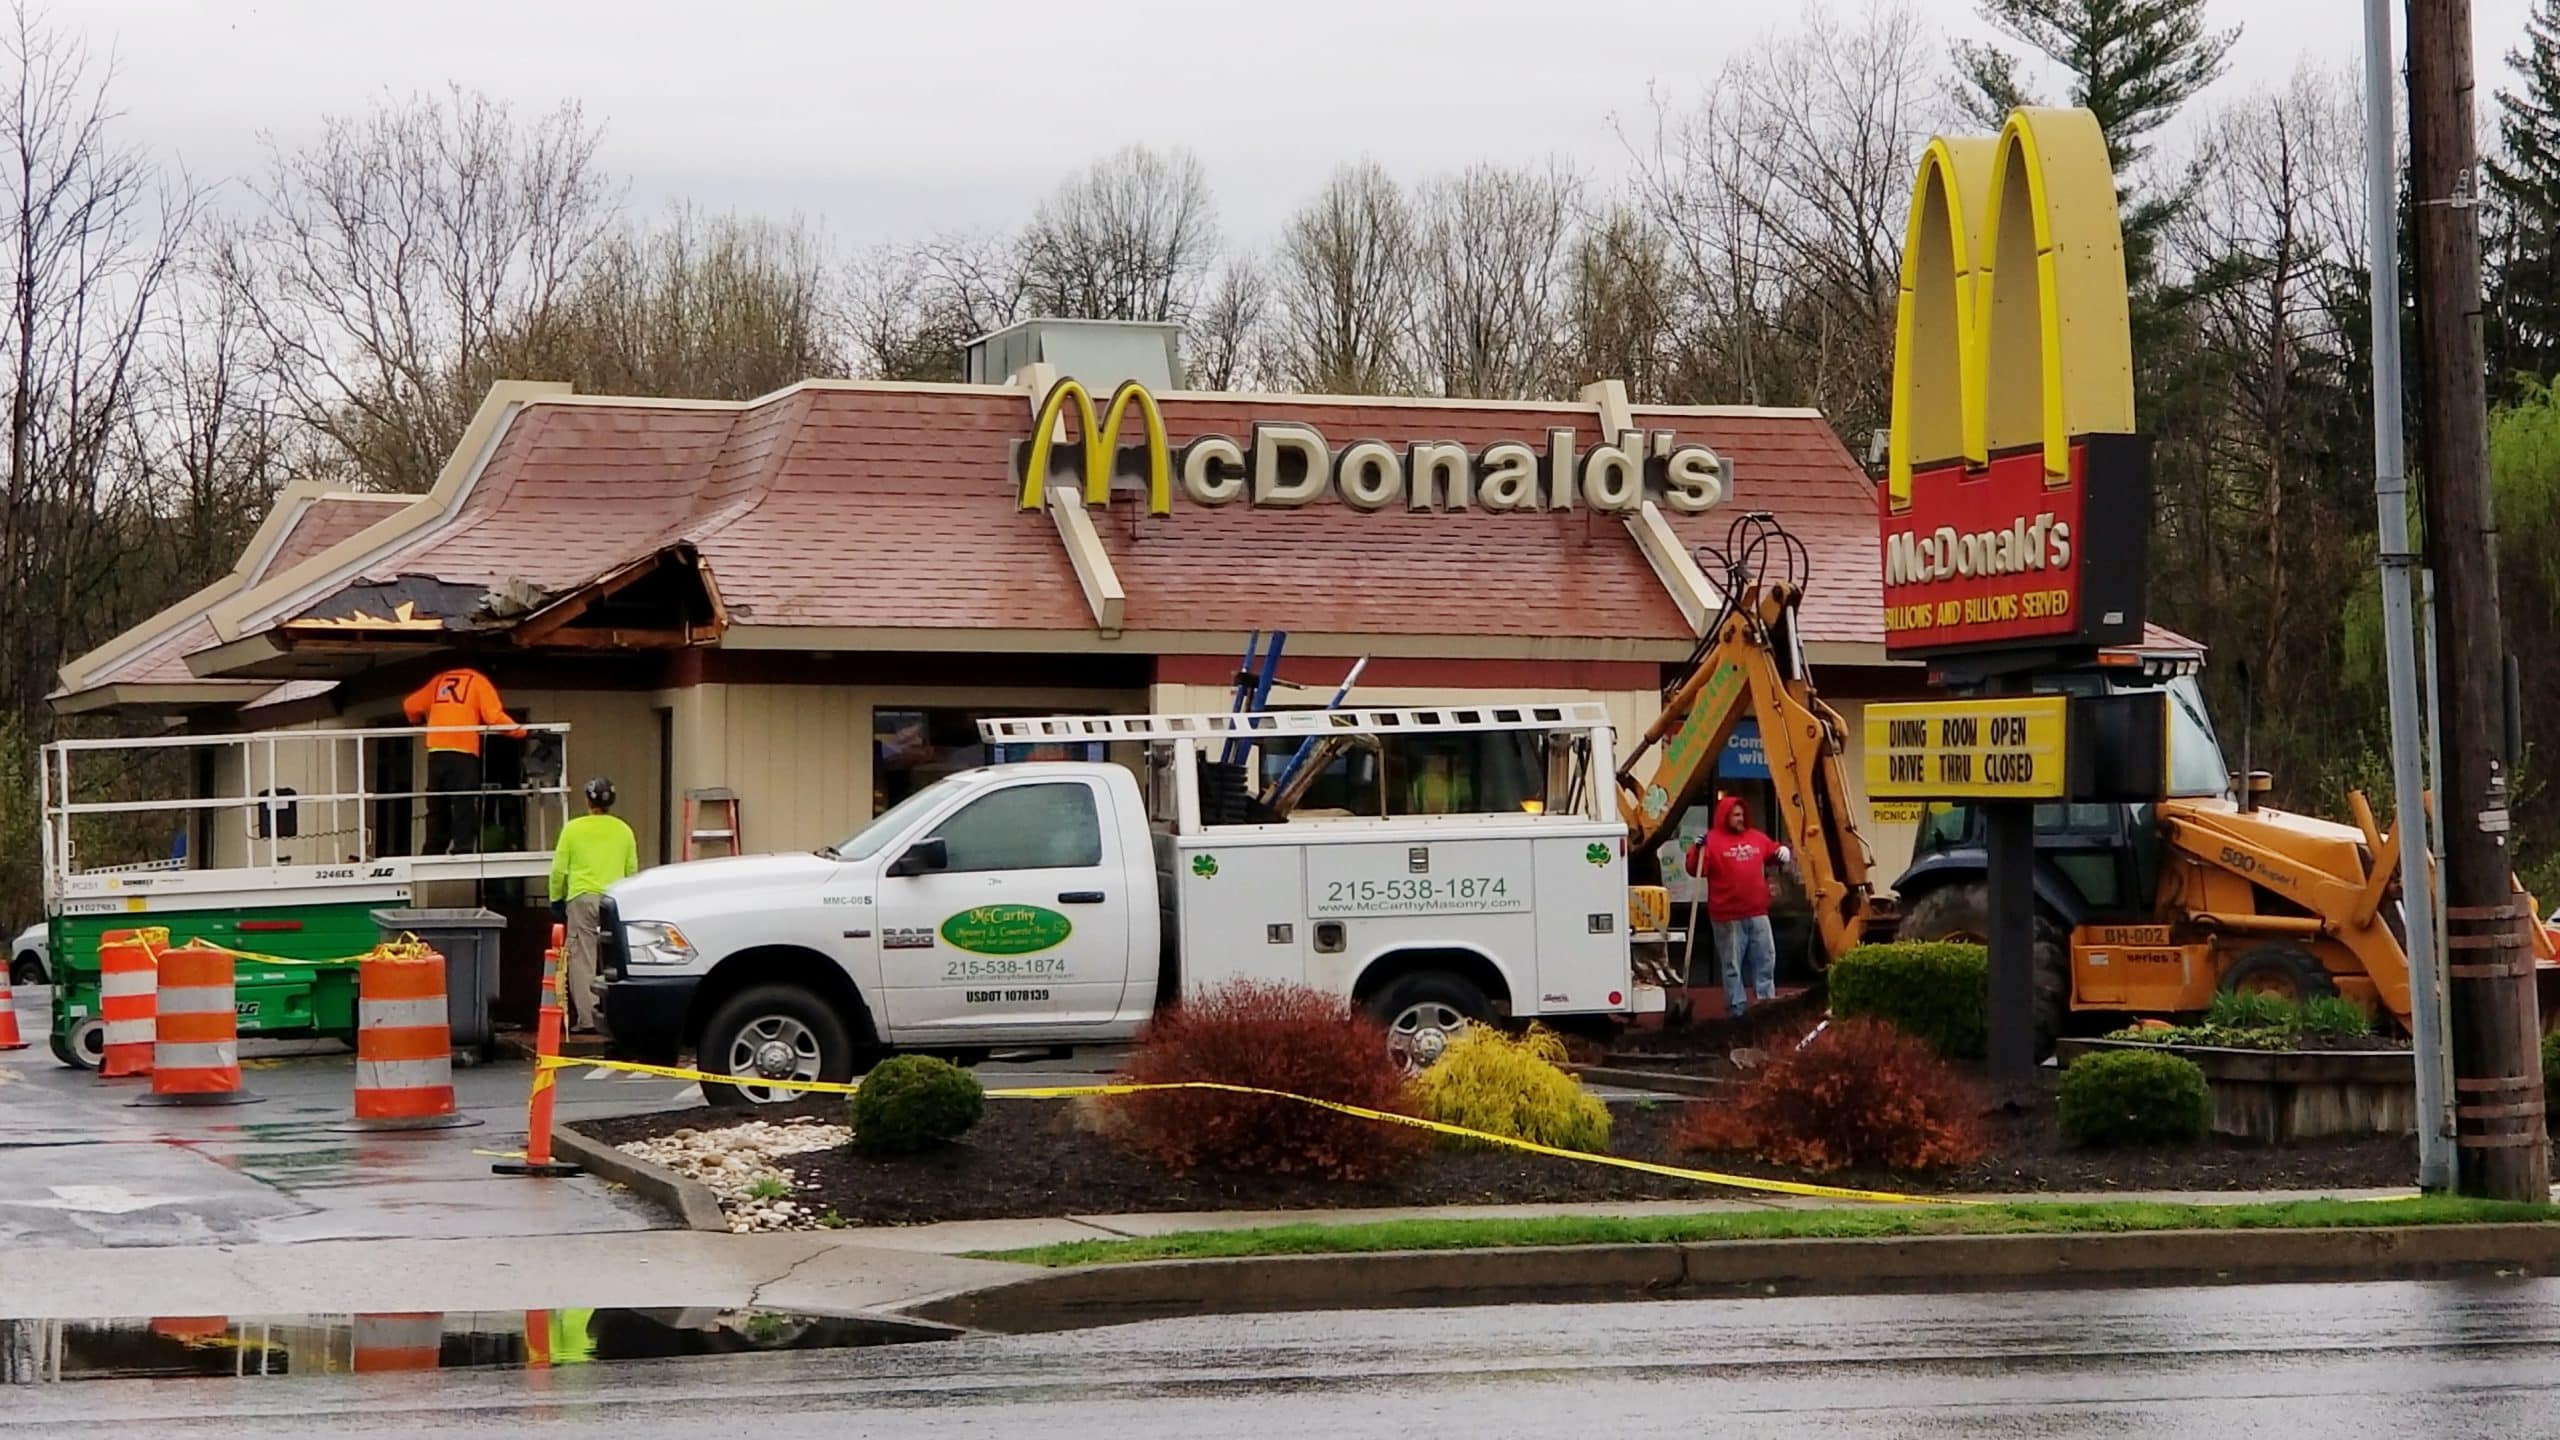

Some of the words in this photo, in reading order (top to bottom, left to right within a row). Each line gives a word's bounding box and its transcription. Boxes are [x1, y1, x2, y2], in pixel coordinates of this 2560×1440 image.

[1018, 377, 1726, 517] McDonald's
[1886, 513, 2070, 587] McDonald's
[1885, 603, 1932, 631] BILLIONS
[1937, 600, 1961, 626] AND
[1965, 594, 2018, 624] BILLIONS
[2022, 590, 2068, 618] SERVED
[1889, 720, 1927, 748] DINING
[1942, 717, 1977, 747] ROOM
[1990, 717, 2026, 747] OPEN
[1727, 735, 1764, 748] Com
[1738, 750, 1769, 765] wit
[1889, 754, 1924, 782] DRIVE
[1939, 754, 1971, 782] THRU
[1984, 753, 2033, 783] CLOSED
[1873, 810, 1907, 821] PICNIC
[368, 867, 395, 878] JLG
[1327, 877, 1508, 902] 215-538-1874
[822, 895, 873, 905] MMC-005
[1317, 898, 1521, 912] www.McCarthyMasonry.com
[969, 907, 1035, 926] McCarthy
[947, 959, 1065, 976] 215-538-1874
[966, 990, 1002, 1003] USDOT
[1005, 988, 1050, 1001] 1078139
[234, 1001, 261, 1016] LG
